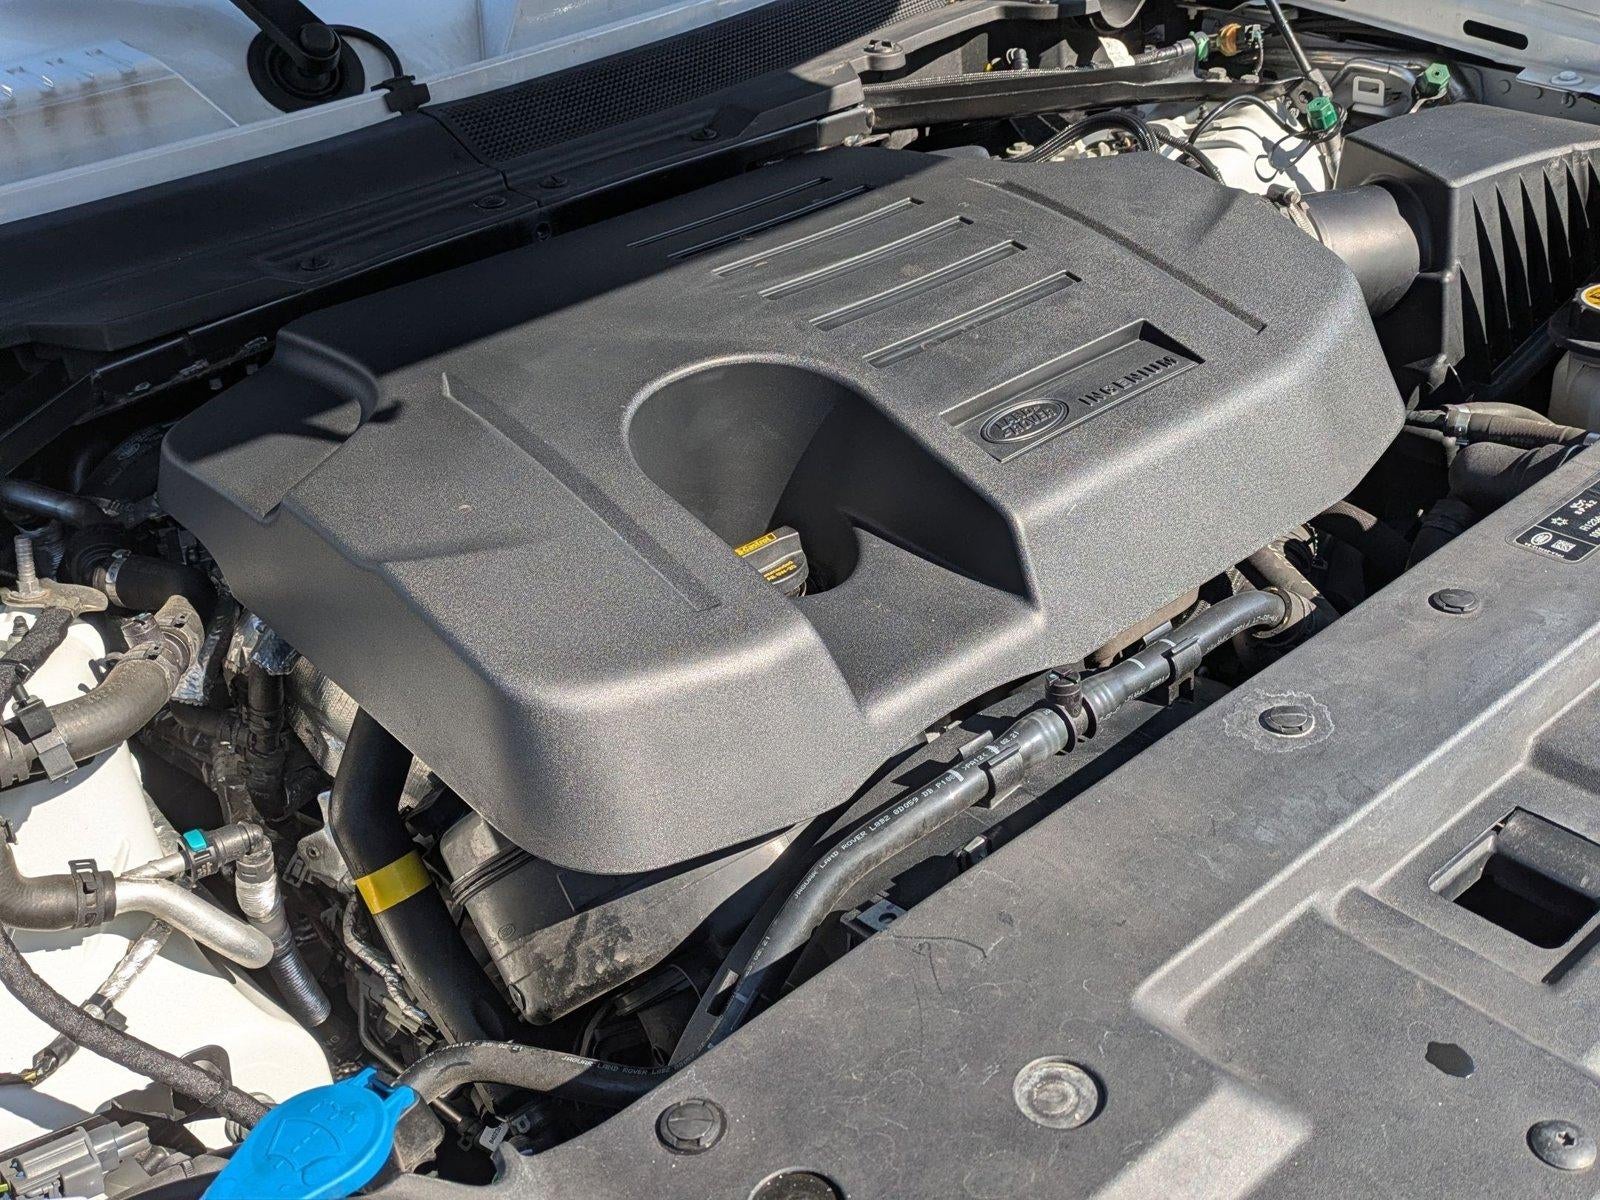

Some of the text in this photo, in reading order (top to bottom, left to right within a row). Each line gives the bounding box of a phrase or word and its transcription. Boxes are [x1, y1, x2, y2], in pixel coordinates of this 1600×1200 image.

[793, 870, 819, 899] JAGUAR
[819, 850, 839, 869] LAND
[841, 830, 868, 851] ROVER
[560, 1055, 593, 1066] JAGUAR
[597, 1063, 619, 1072] LAND
